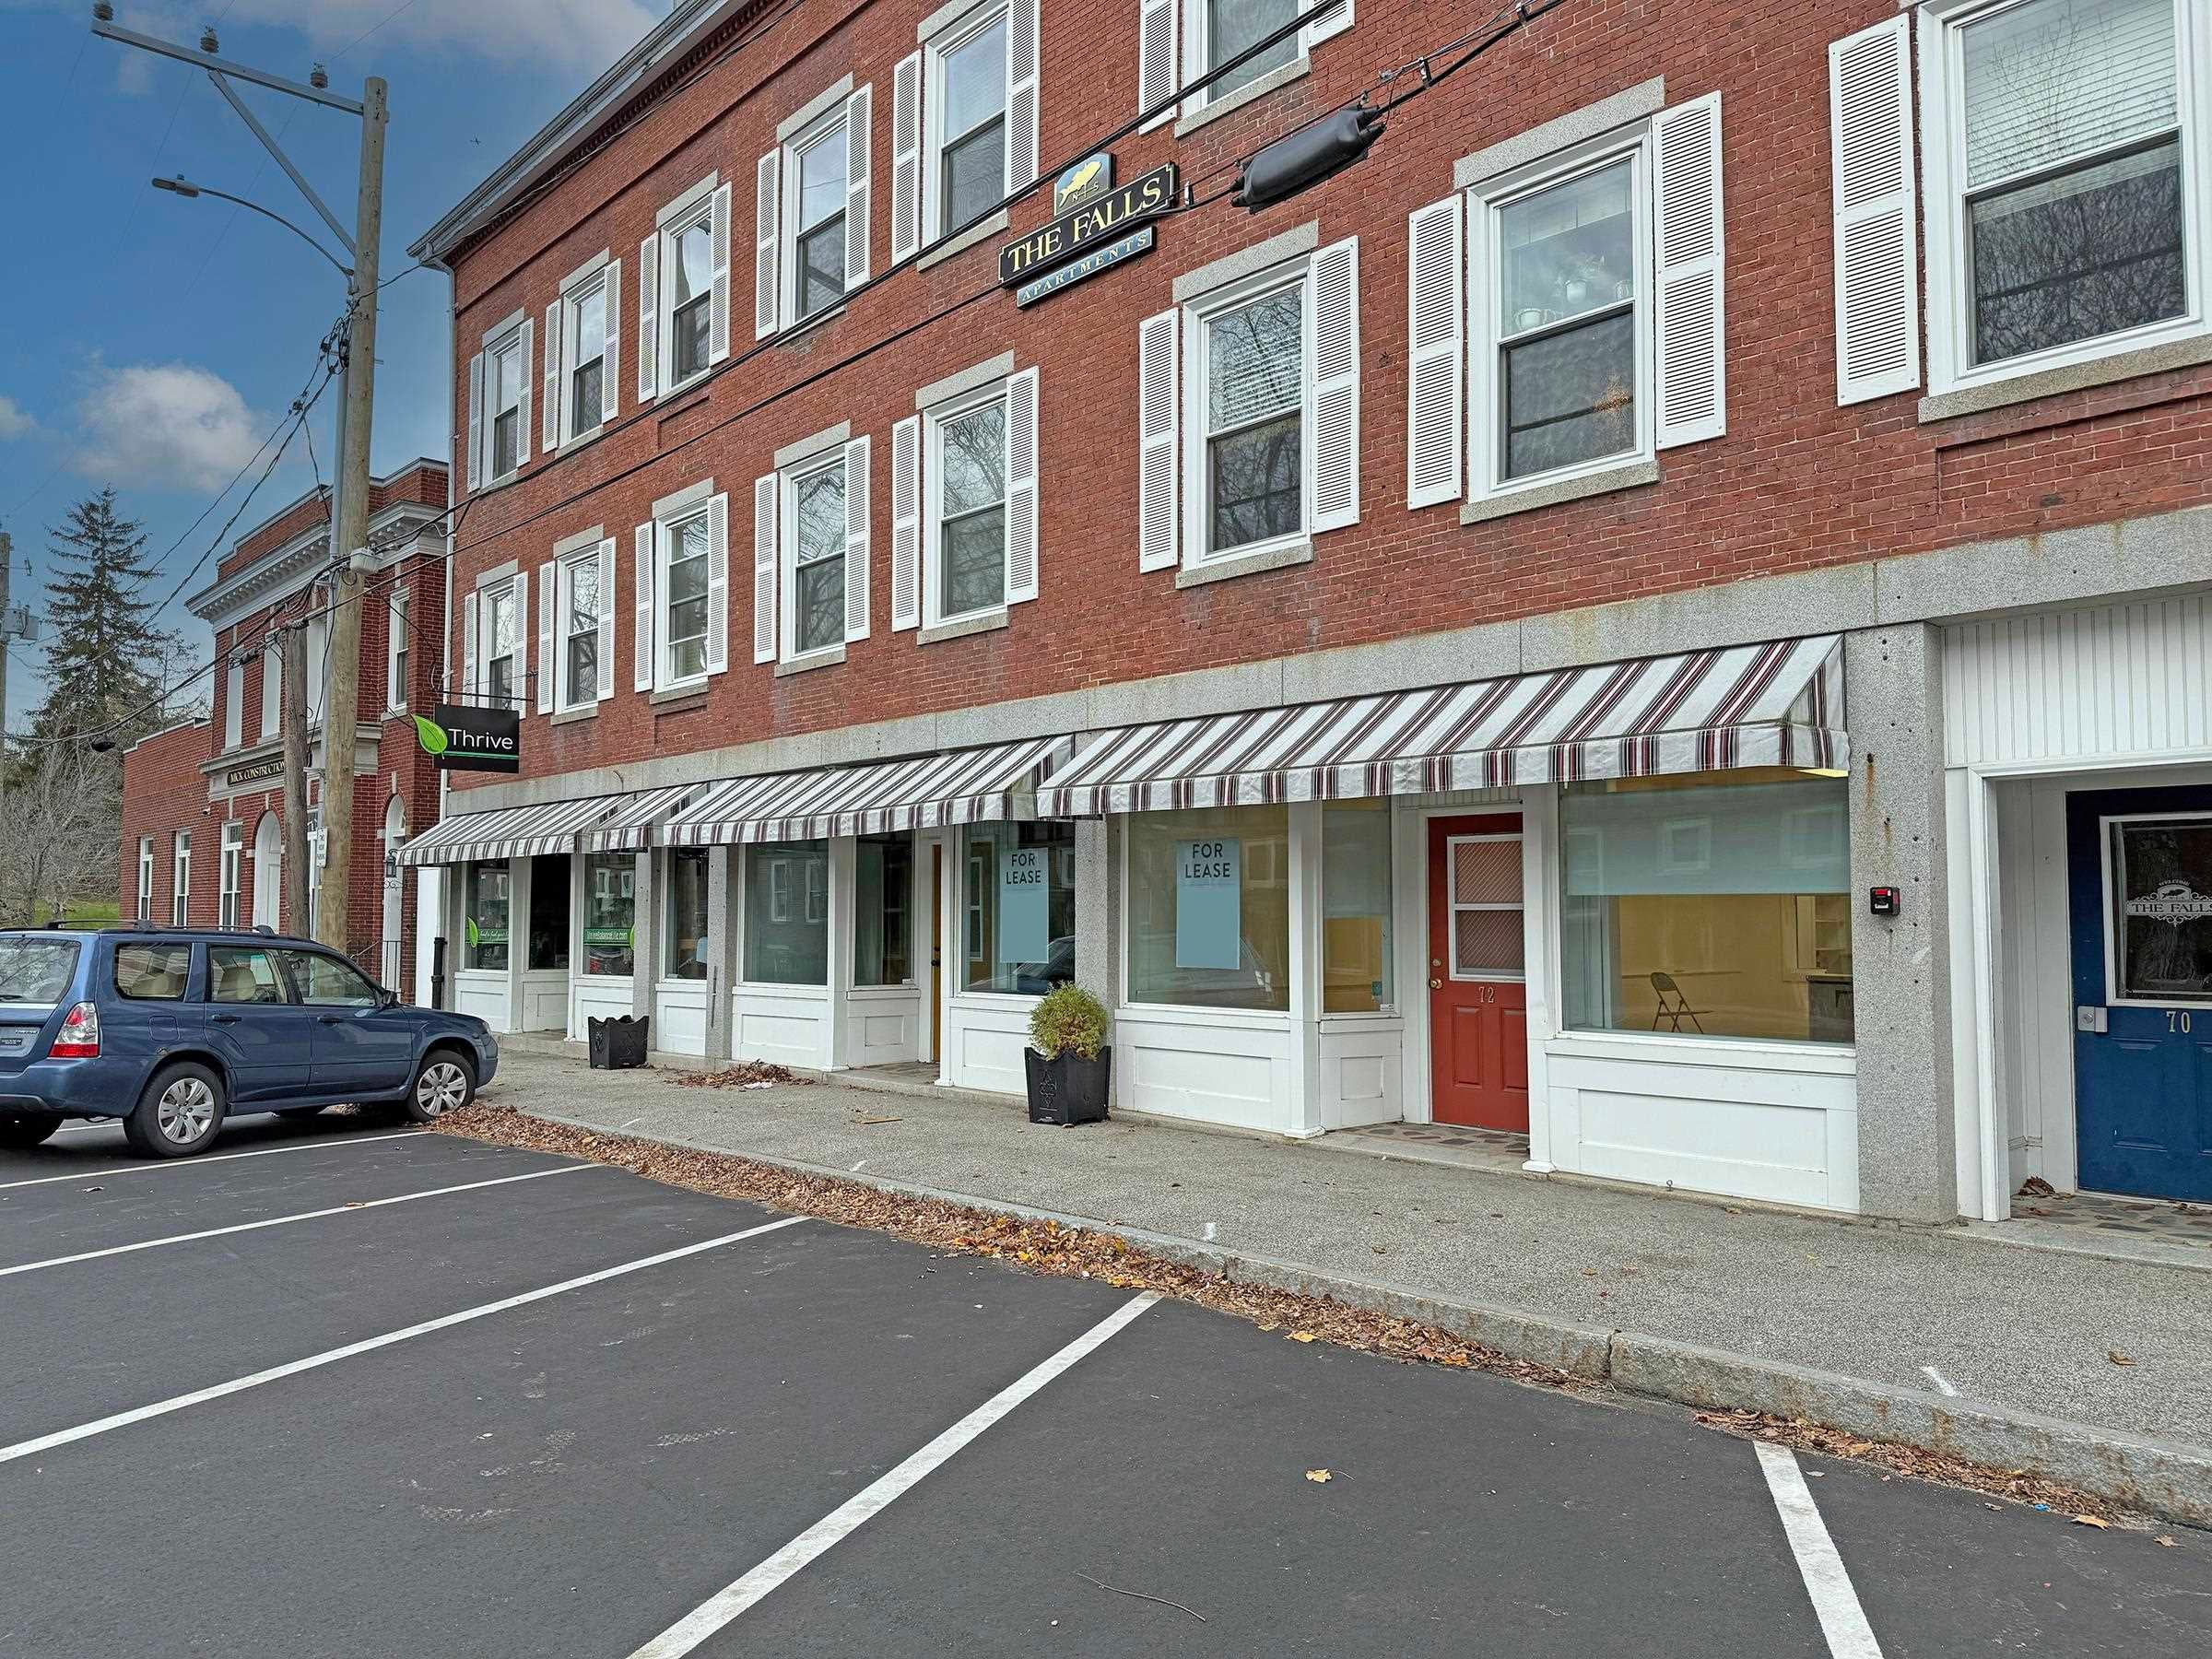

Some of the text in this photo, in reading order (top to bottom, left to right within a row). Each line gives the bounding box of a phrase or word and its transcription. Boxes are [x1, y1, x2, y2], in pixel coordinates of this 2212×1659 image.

[1007, 177, 1162, 273] THE FALLS
[1021, 233, 1147, 300] APARTMENTS
[448, 728, 513, 749] Thrive
[1192, 843, 1223, 858] FOR
[1011, 853, 1035, 866] FOR
[1006, 870, 1041, 885] LEASE
[1185, 863, 1230, 878] LEASE
[2132, 903, 2164, 912] THE
[1478, 986, 1494, 1003] 72
[2166, 1011, 2191, 1033] 70
